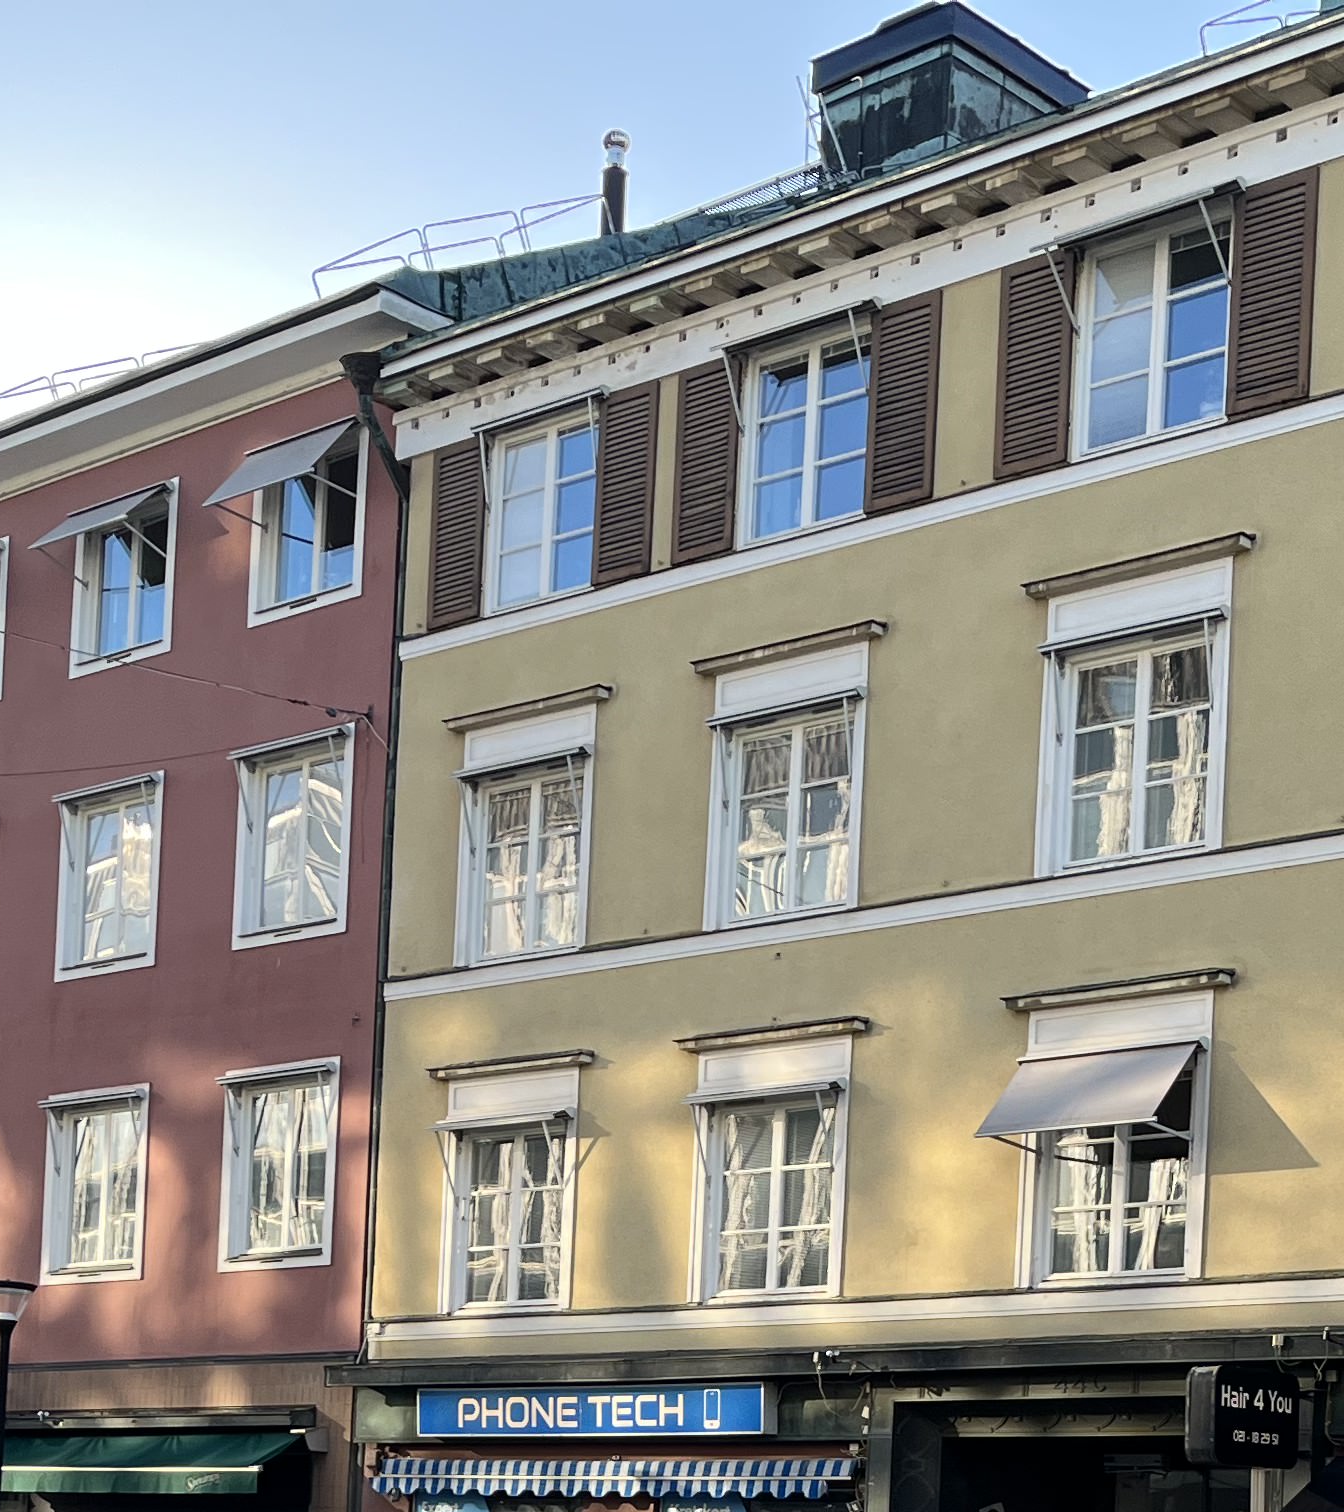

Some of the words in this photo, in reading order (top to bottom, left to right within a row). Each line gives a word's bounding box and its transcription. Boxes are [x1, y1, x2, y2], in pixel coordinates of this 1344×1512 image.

[458, 1396, 578, 1429] PHONE
[587, 1393, 684, 1428] TECH
[1220, 1384, 1250, 1409] Hair
[1253, 1388, 1264, 1411] 4
[1268, 1389, 1292, 1414] You
